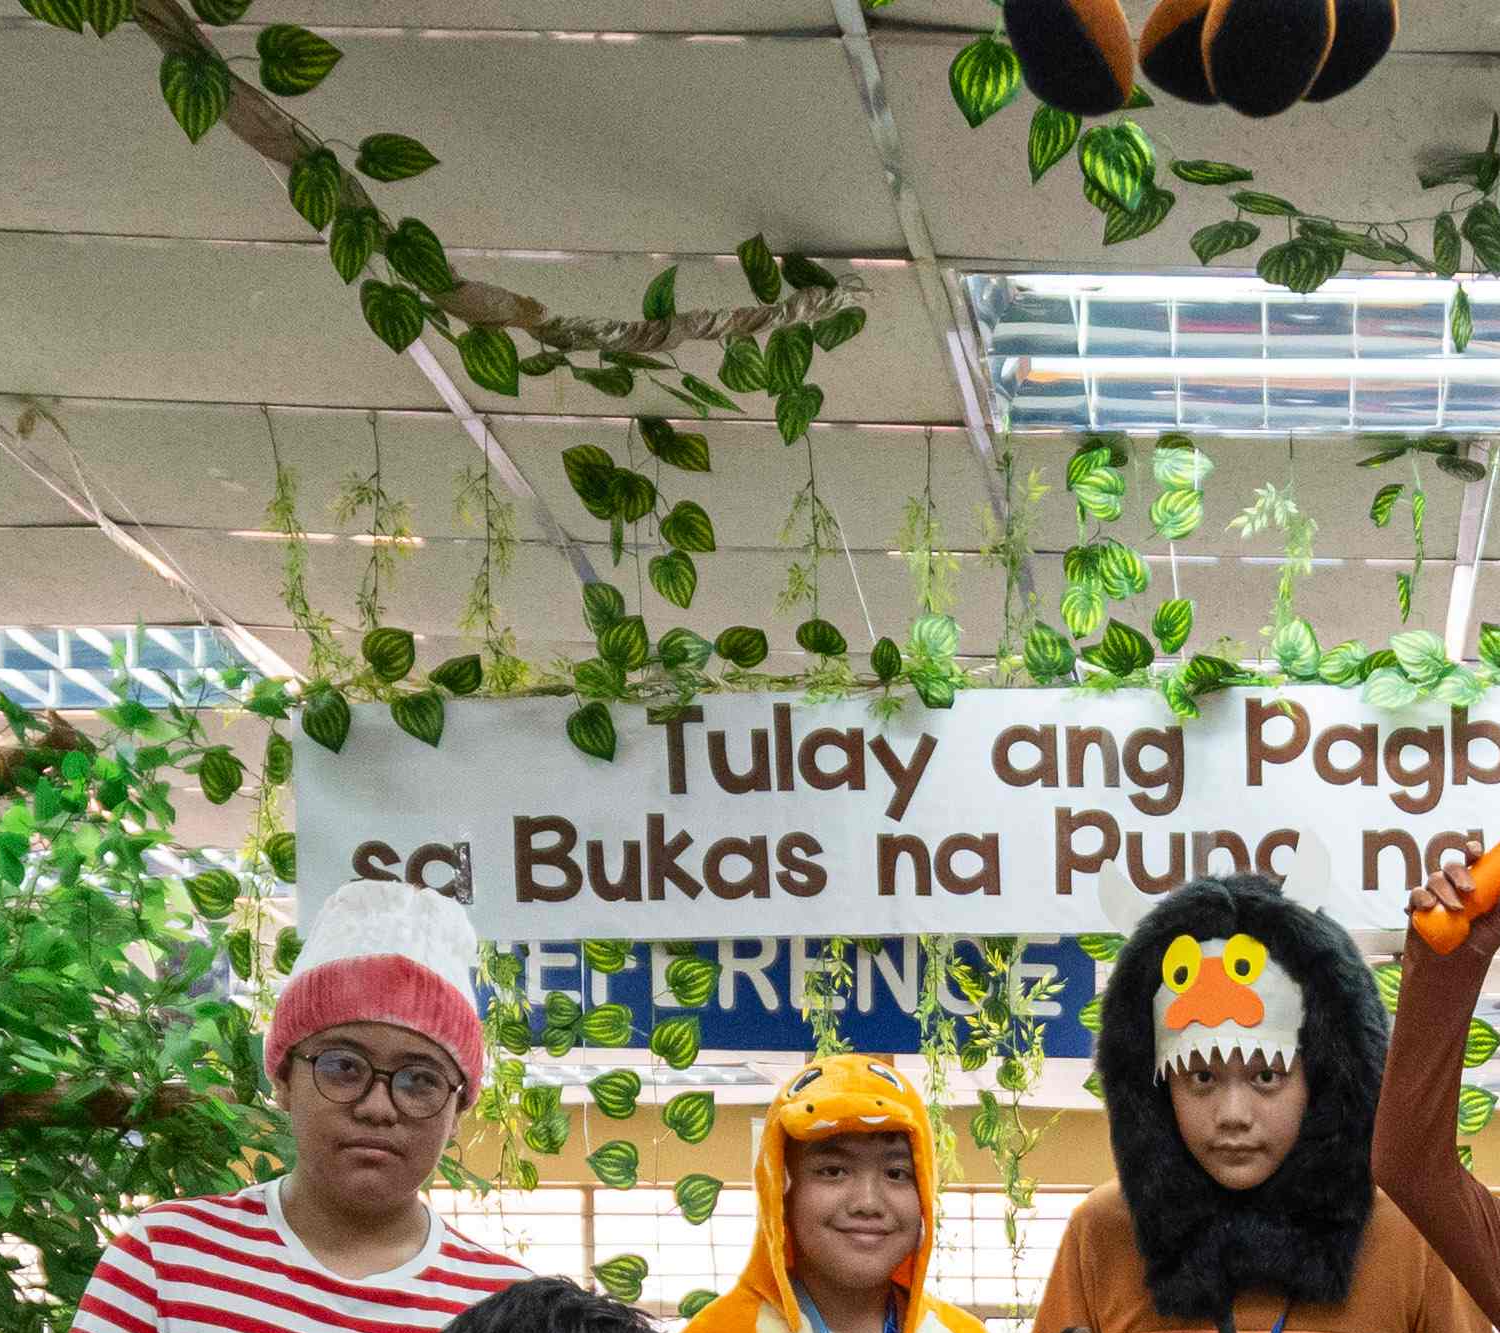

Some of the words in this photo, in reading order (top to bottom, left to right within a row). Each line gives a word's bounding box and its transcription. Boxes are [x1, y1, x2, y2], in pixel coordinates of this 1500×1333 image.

[646, 702, 938, 822] Tulay
[991, 722, 1185, 817] ang
[352, 840, 474, 904] sa
[514, 812, 828, 902] Bukas
[877, 831, 1001, 896] na
[525, 938, 1062, 1014] EFERENCE
